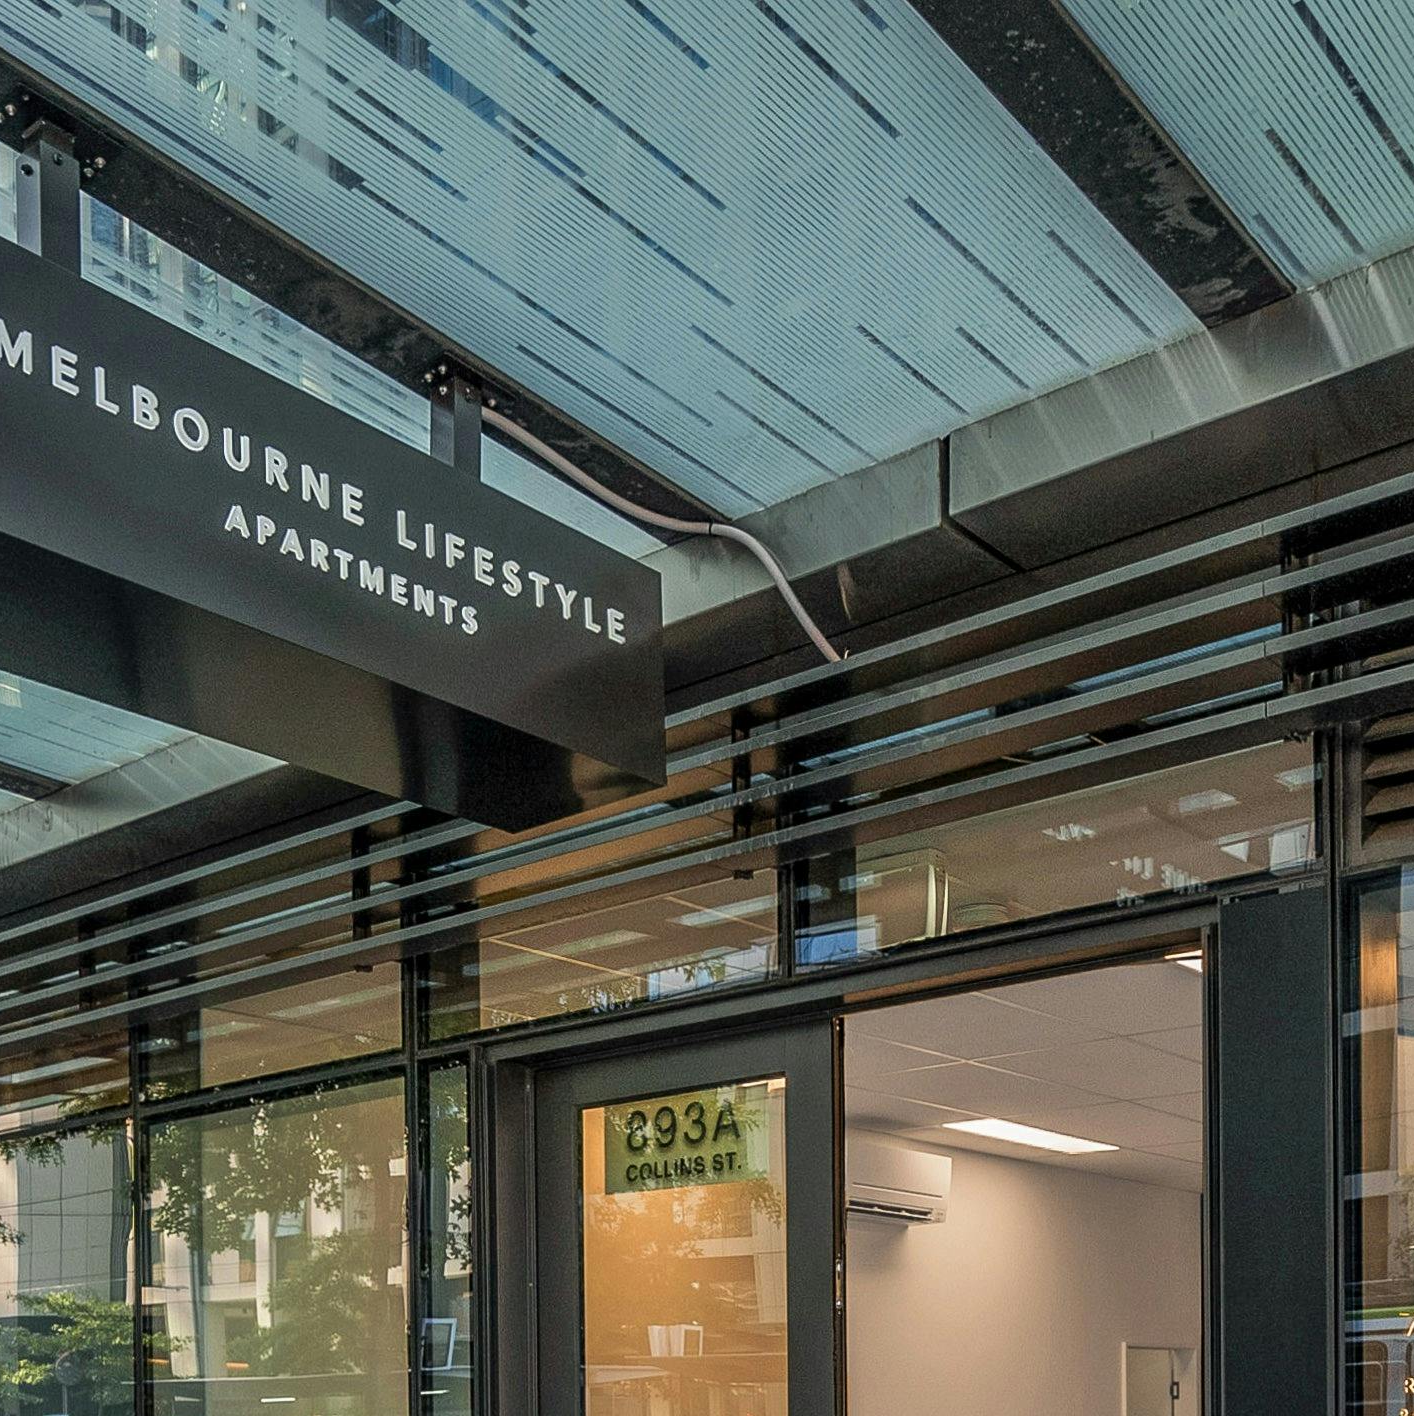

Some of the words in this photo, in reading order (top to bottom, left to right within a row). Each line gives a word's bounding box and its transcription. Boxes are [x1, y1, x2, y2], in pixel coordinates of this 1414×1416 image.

[224, 504, 480, 635] APARTMENTS
[395, 508, 626, 646] LIFESTYLE
[625, 1098, 742, 1151] 893A
[625, 1156, 706, 1182] COLLINS
[712, 1152, 742, 1171] ST.
